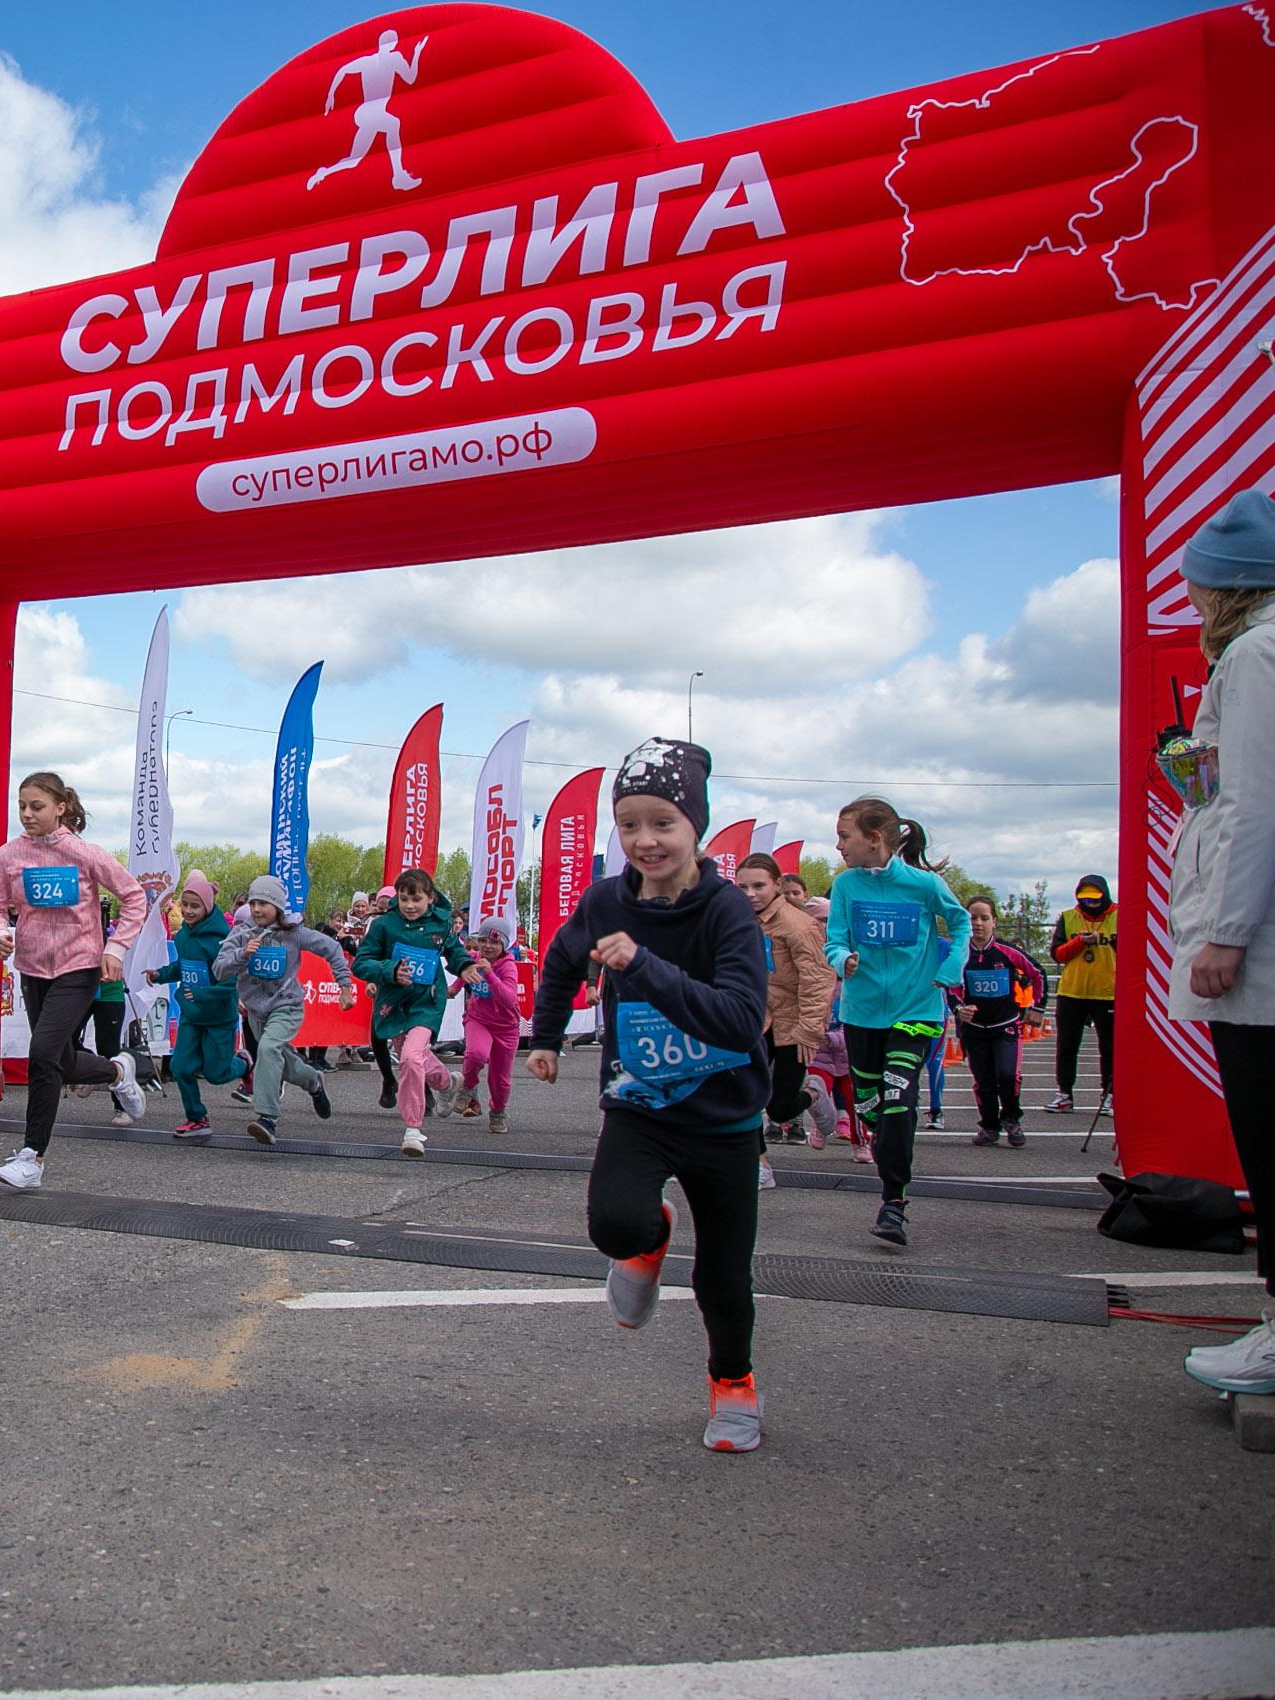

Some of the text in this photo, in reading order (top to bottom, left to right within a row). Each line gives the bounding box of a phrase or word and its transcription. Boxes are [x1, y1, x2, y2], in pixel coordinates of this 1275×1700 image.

[59, 151, 786, 372] СУПЕРЛИГА
[57, 260, 787, 450] ПОДМОСКОВЬЯ
[231, 421, 553, 501] суперлигамо.рф
[136, 751, 148, 856] Команда
[402, 764, 416, 872] ЕРЛИГА
[32, 882, 63, 900] 324
[559, 816, 575, 916] БЕГОВАЯ ЛИГА
[867, 920, 894, 938] 311
[254, 958, 280, 972] 340
[406, 961, 425, 976] 56
[975, 980, 998, 993] 320
[637, 1034, 708, 1069] 360
